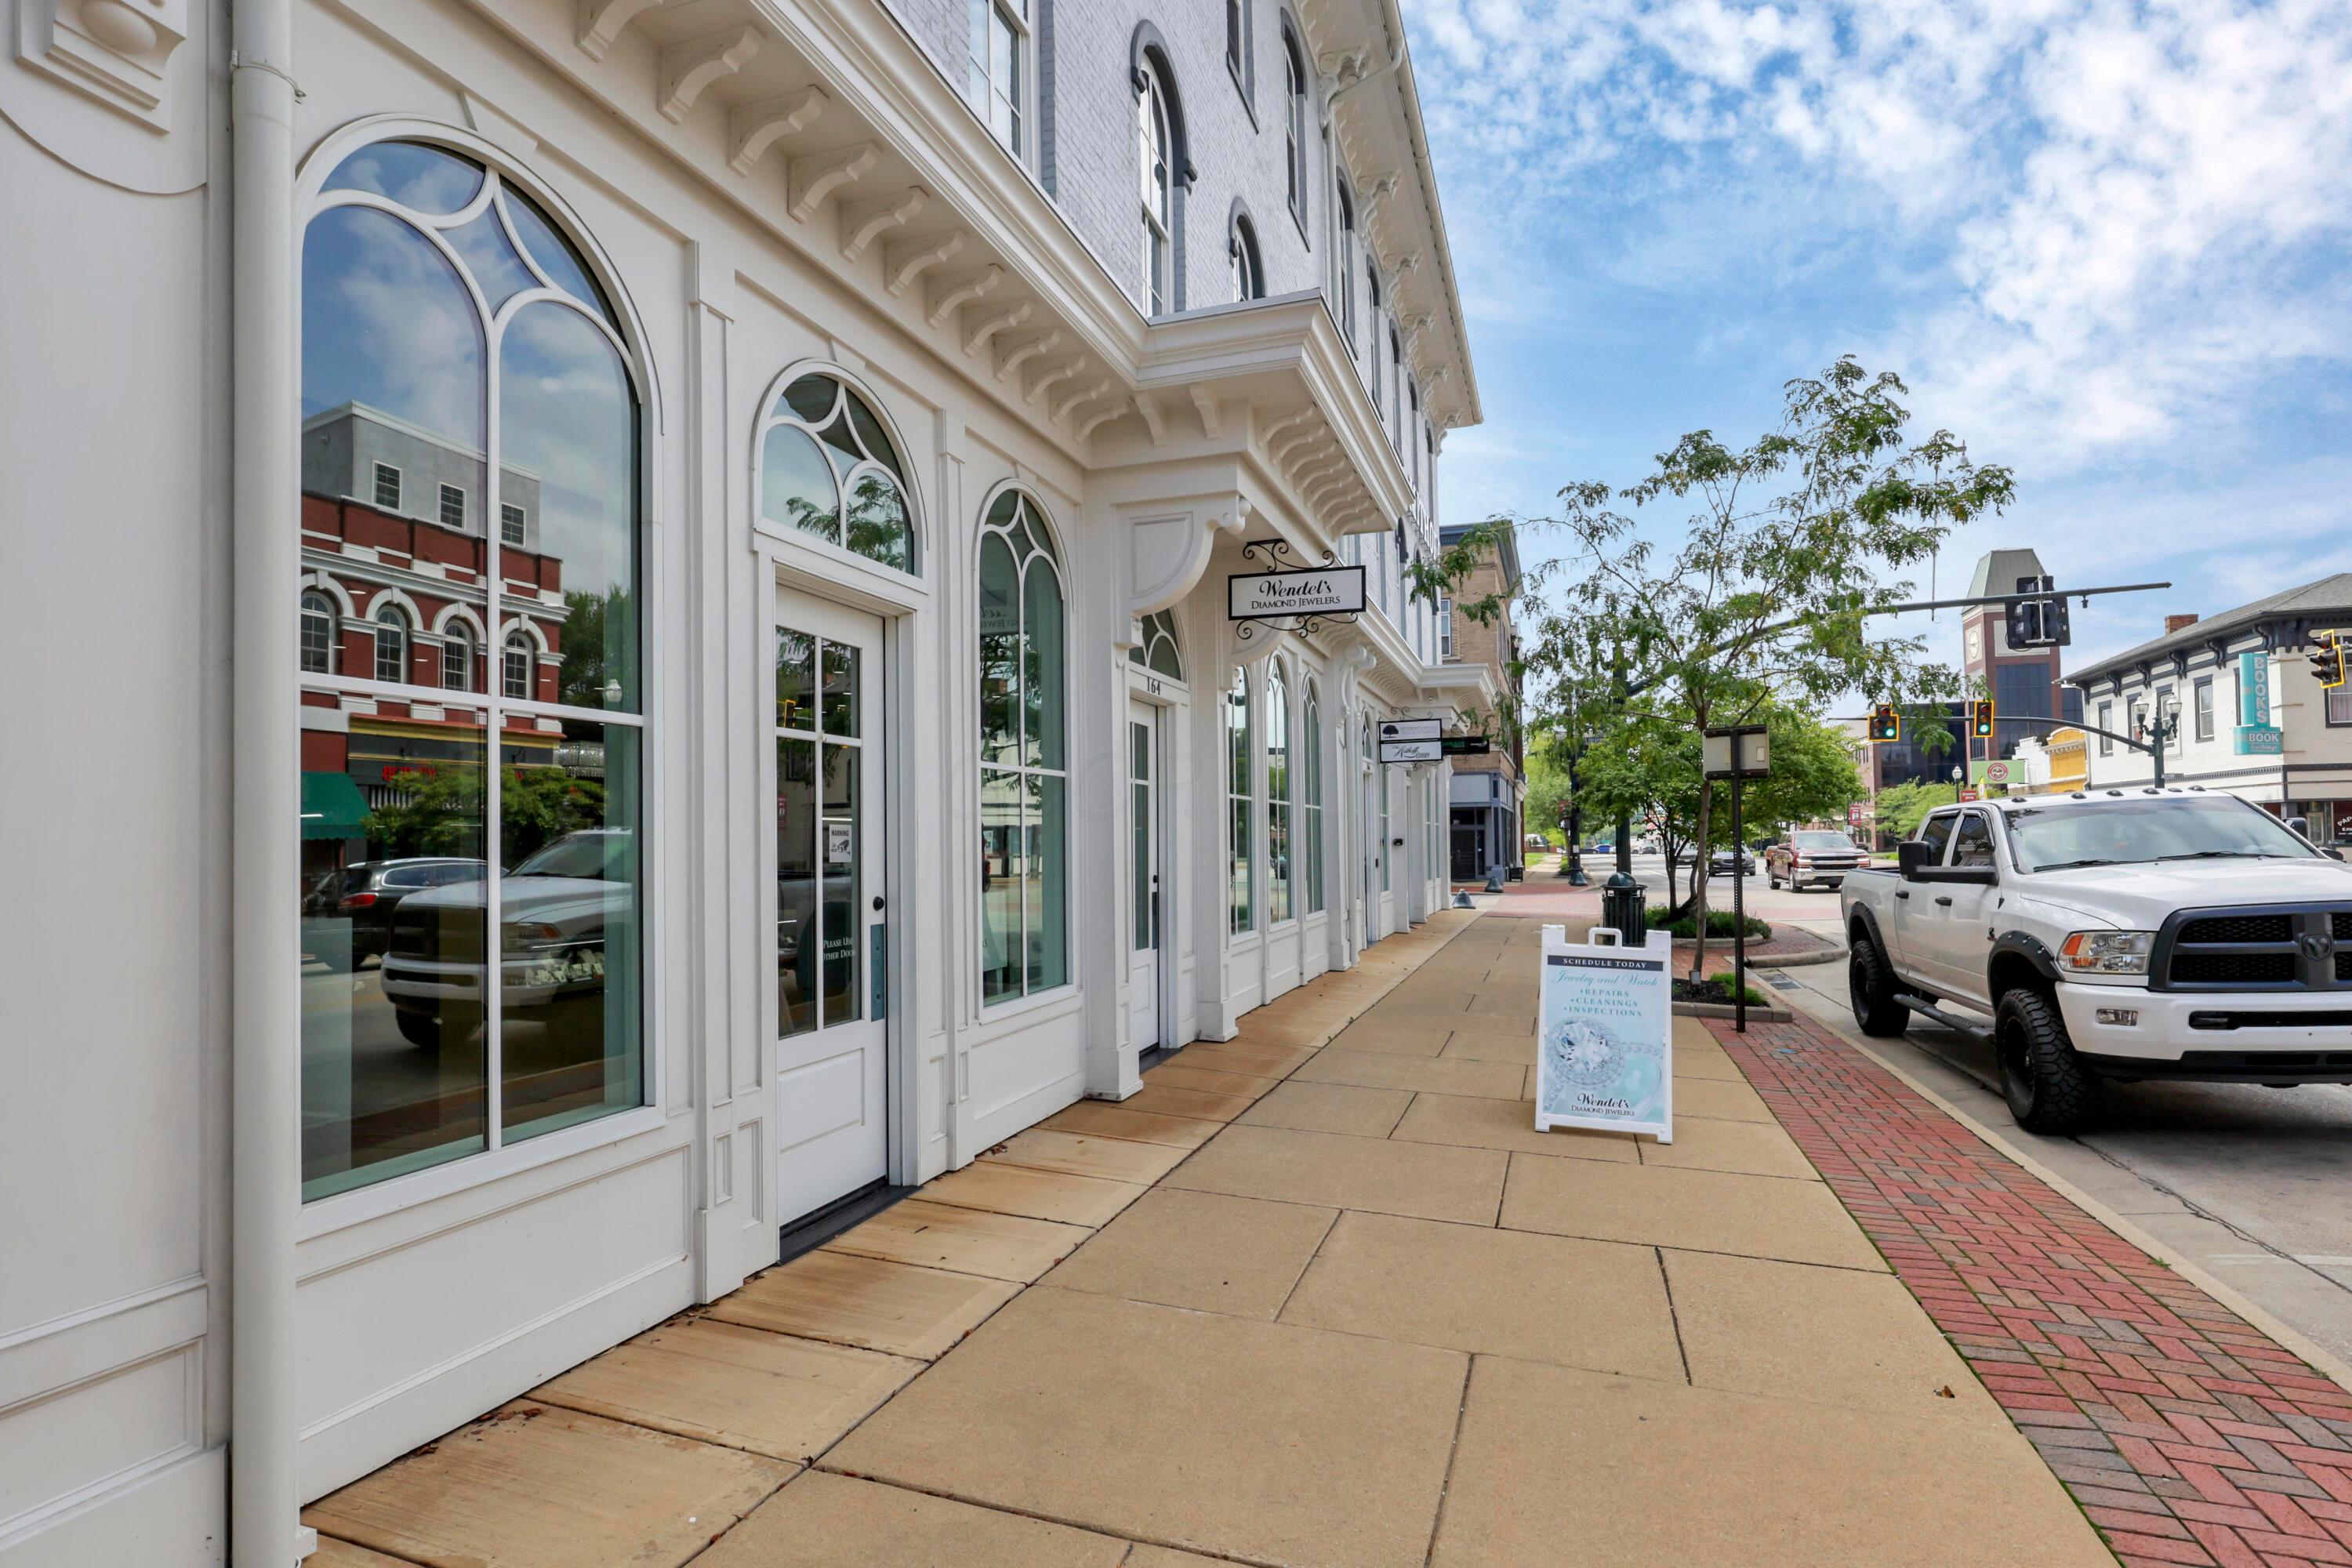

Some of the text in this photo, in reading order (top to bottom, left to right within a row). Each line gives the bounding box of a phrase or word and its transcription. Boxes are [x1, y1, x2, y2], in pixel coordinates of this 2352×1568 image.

[1259, 579, 1332, 597] Wendel's
[1251, 596, 1341, 609] DIAMOND JEWELERS
[1147, 676, 1161, 695] 164
[2254, 656, 2267, 723] BOOKS
[2249, 733, 2279, 742] BOOK
[2337, 816, 2352, 826] PAP
[823, 939, 843, 949] PLEASE
[1563, 958, 1612, 967] SCHEDULE
[1553, 970, 1657, 986] Jewelry and Watch
[1584, 989, 1630, 997] REPAIRS
[1576, 998, 1639, 1007] CLEANINGS
[1569, 1006, 1642, 1017] INSPECTIONS
[1577, 1093, 1629, 1109] Wendel's
[1571, 1105, 1635, 1116] DIAMOND JEWELERS
